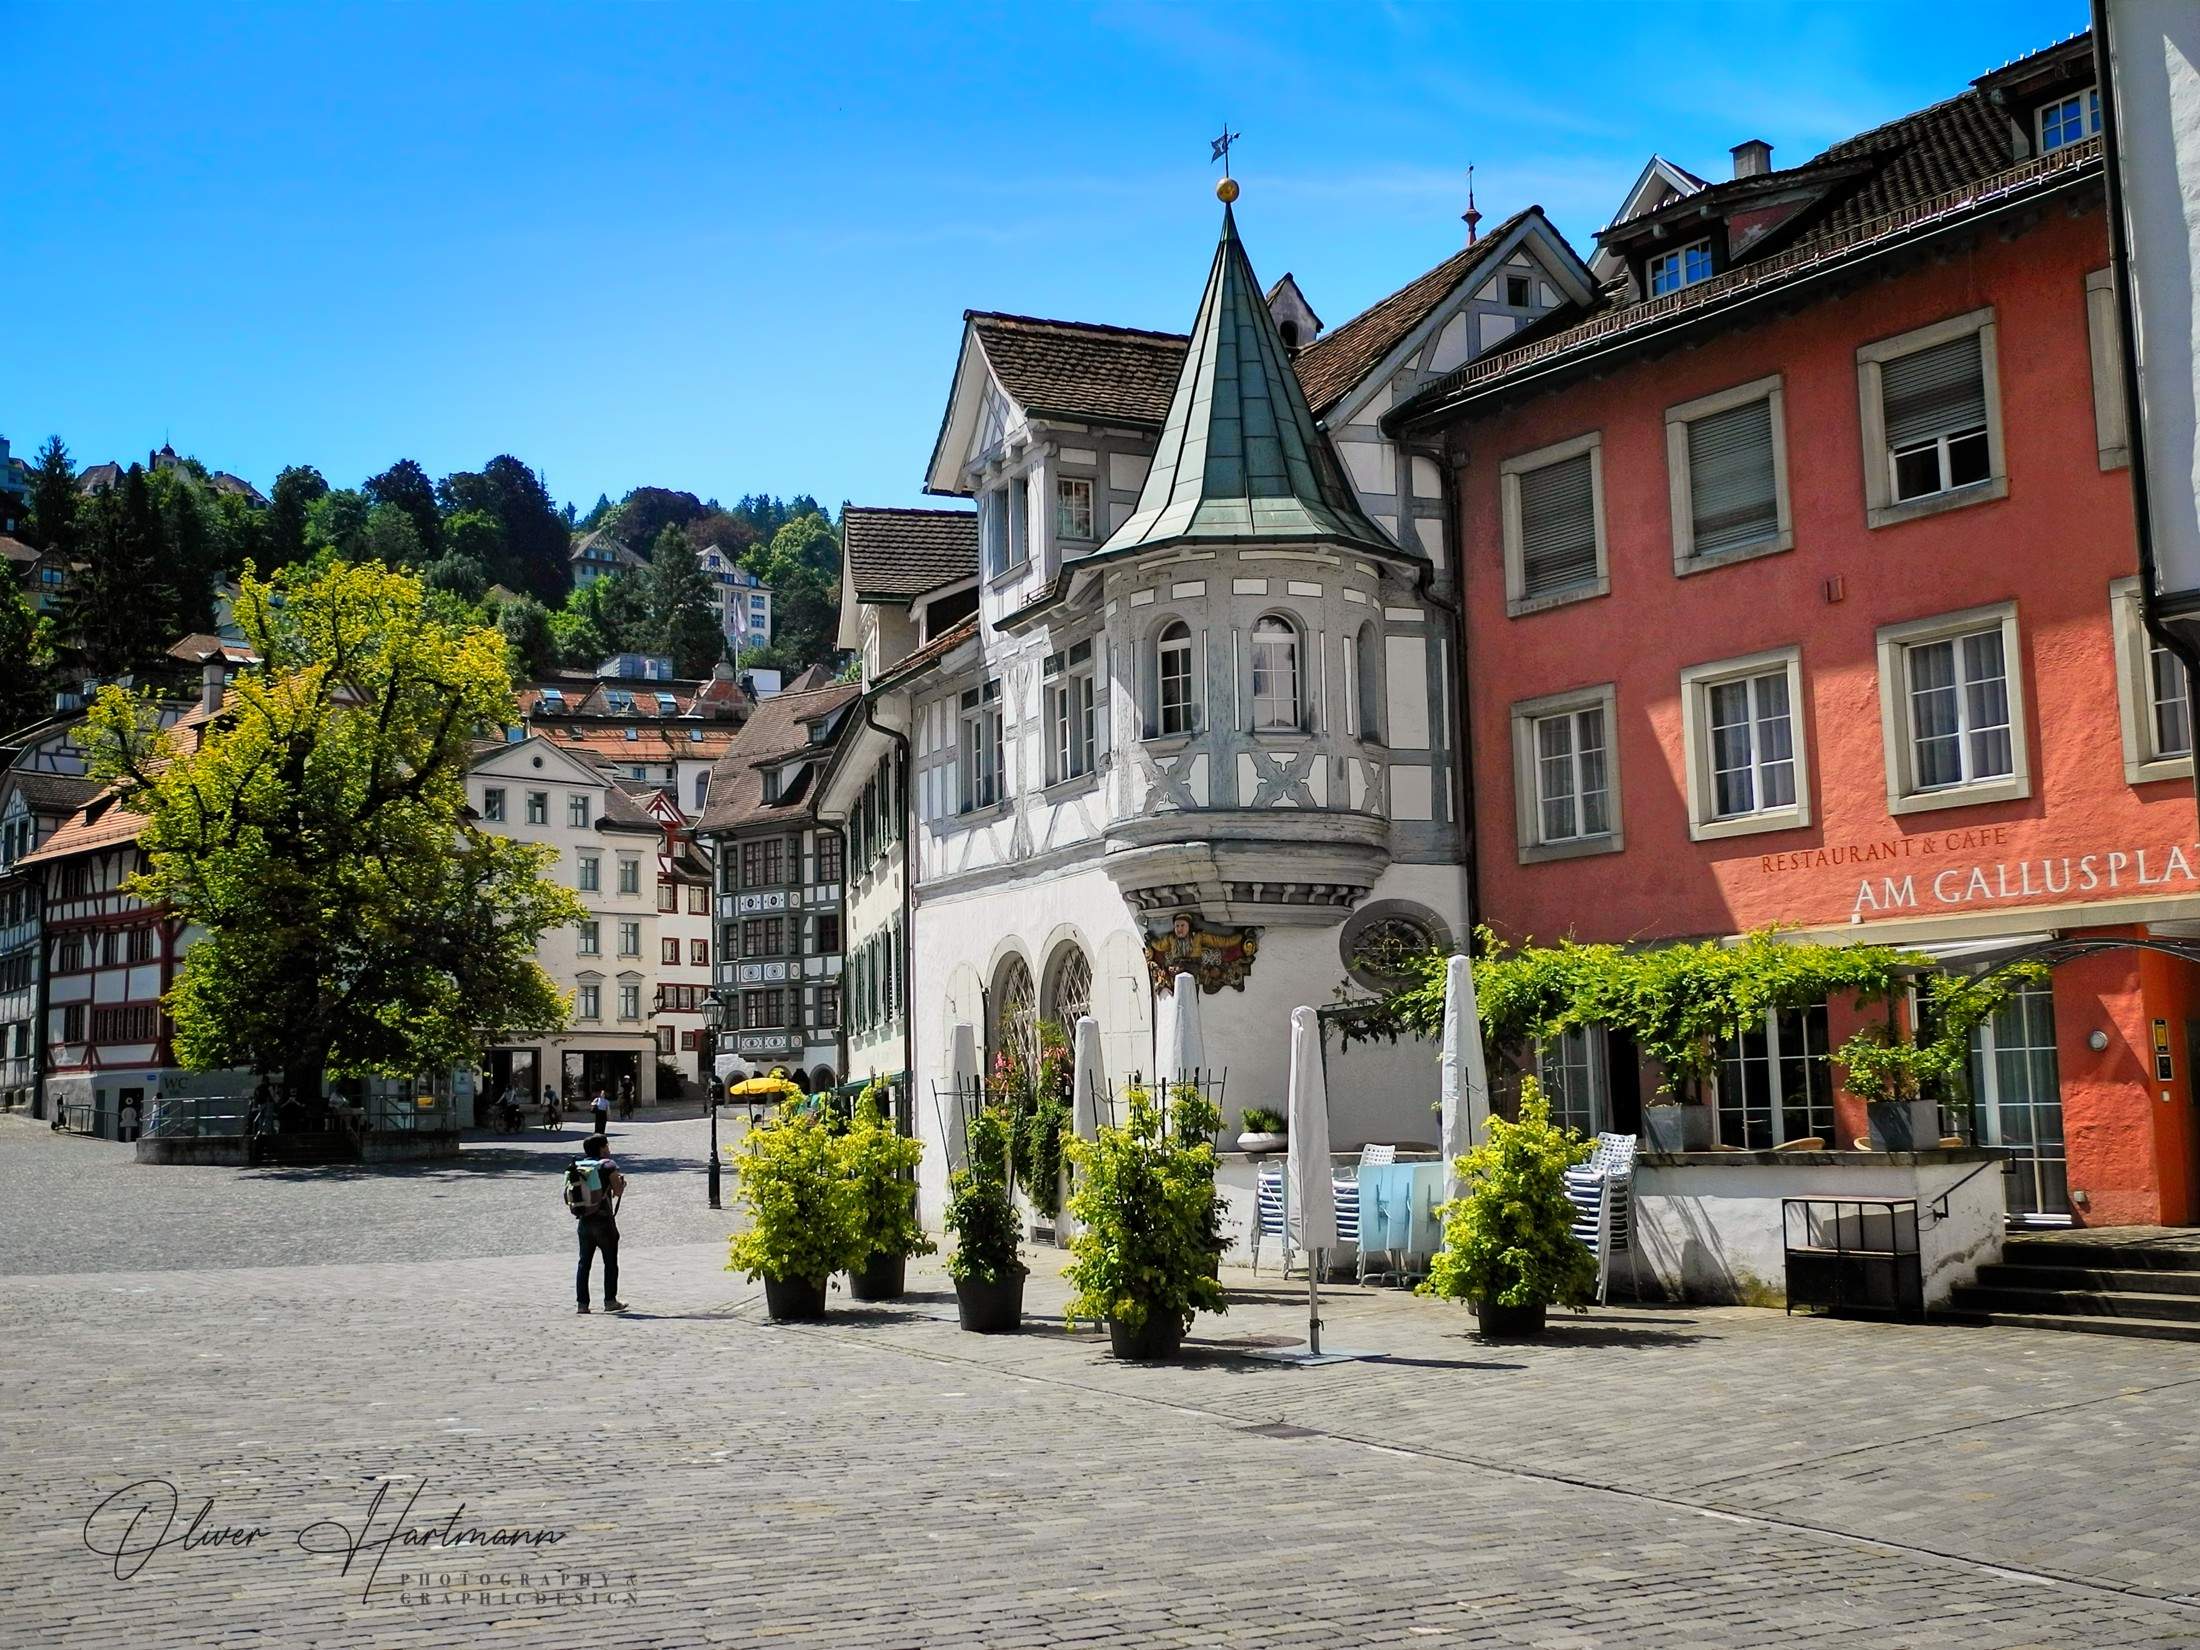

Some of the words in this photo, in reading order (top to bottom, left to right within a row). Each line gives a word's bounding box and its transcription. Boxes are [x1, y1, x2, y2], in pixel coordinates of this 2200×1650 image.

[1761, 837, 1914, 874] RESTAURANT
[1923, 837, 1936, 854] &
[1853, 875, 1918, 913] AM
[1933, 843, 2200, 903] GALLUSPLA
[164, 1077, 188, 1089] WC
